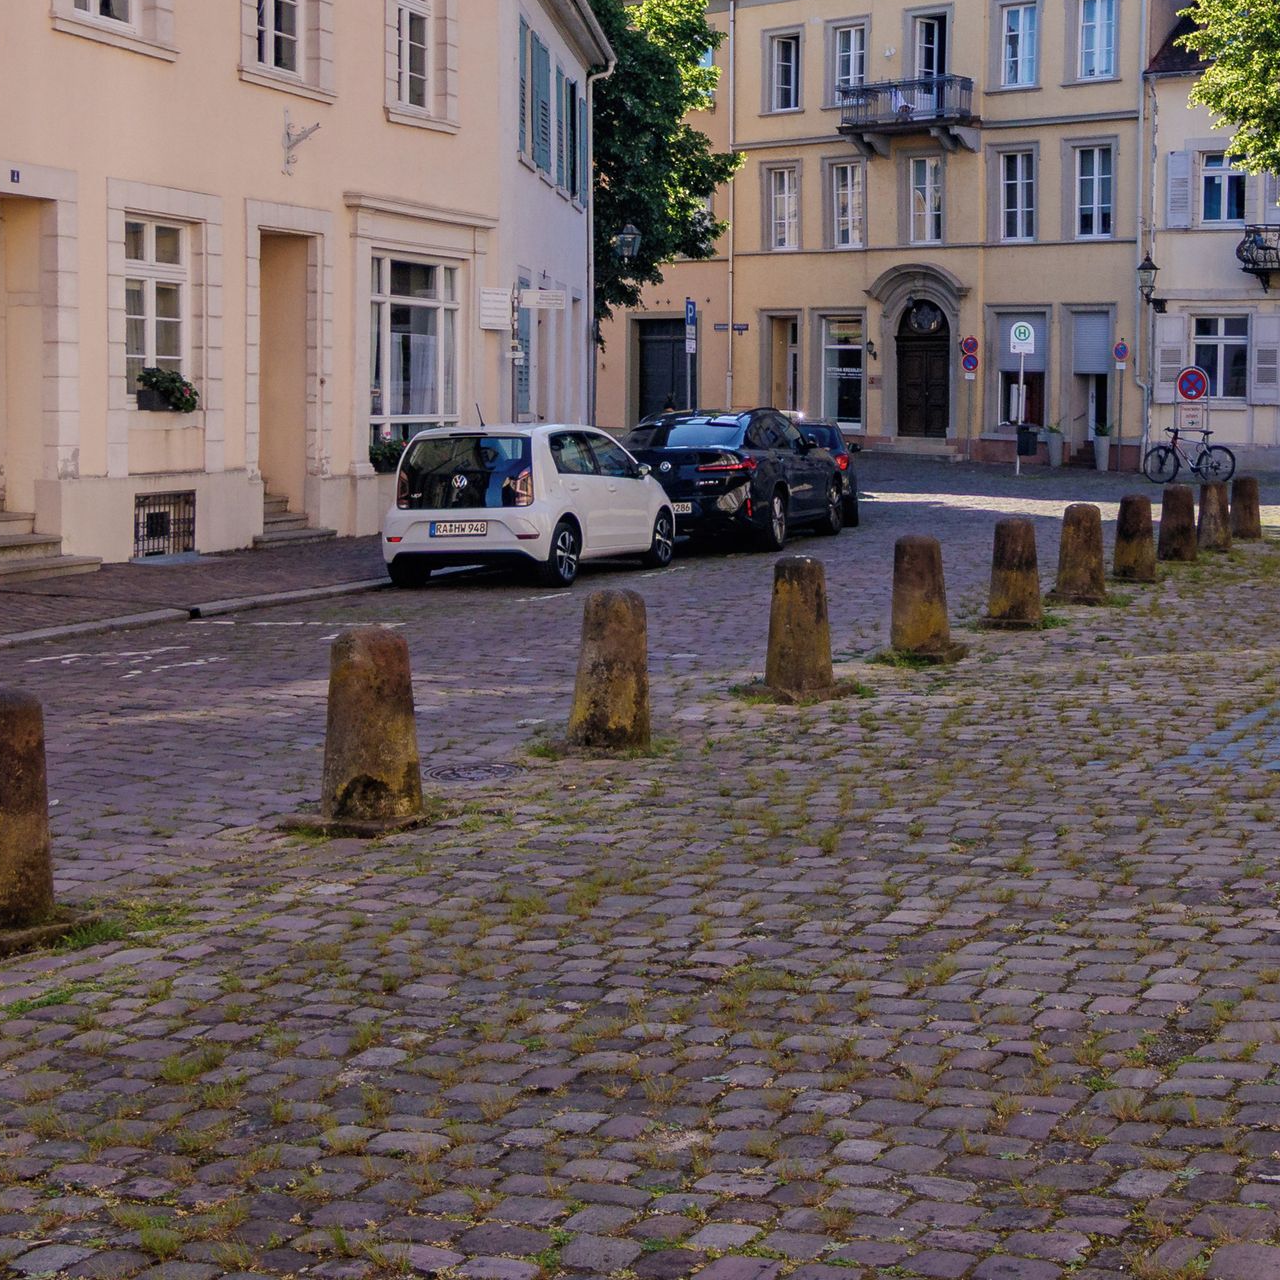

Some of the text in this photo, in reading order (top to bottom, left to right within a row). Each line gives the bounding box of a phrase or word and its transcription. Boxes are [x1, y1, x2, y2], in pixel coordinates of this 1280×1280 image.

[687, 304, 694, 324] P
[1018, 328, 1026, 338] H
[435, 522, 486, 534] RA HW 948
